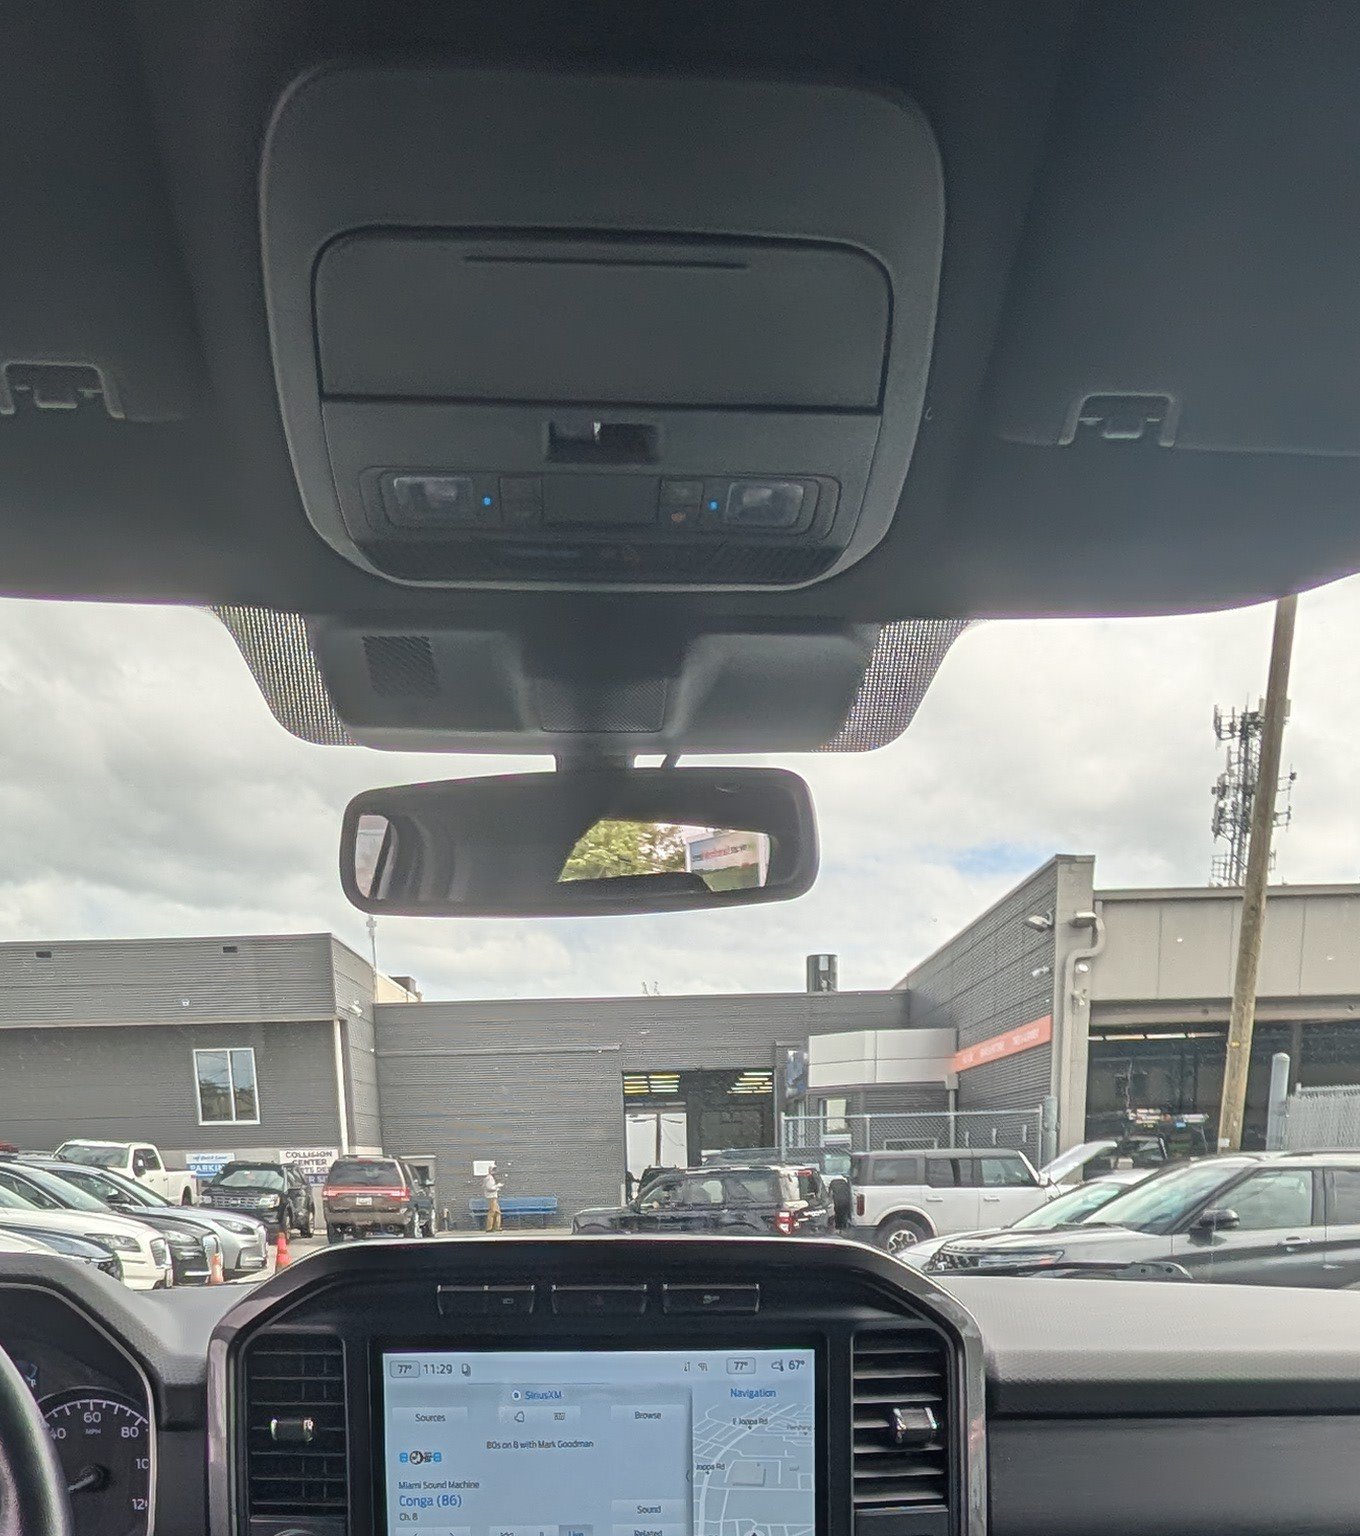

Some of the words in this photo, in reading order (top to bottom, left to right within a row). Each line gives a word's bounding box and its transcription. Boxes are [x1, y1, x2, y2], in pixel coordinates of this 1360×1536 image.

[285, 1151, 332, 1159] COLLISION
[397, 1365, 412, 1374] 77°
[423, 1364, 453, 1375] 11:29
[733, 1361, 749, 1371] 77°
[730, 1388, 776, 1399] Navigation
[83, 1412, 101, 1423] 60
[415, 1413, 446, 1422] Sources
[634, 1411, 662, 1420] Browse
[121, 1426, 139, 1438] 80
[520, 1440, 537, 1449] with
[398, 1481, 422, 1490] Miami
[423, 1480, 447, 1489] Sound
[448, 1480, 480, 1489] Machine
[399, 1495, 434, 1508] Conga
[436, 1494, 462, 1507] (86)
[637, 1505, 661, 1514] Sound
